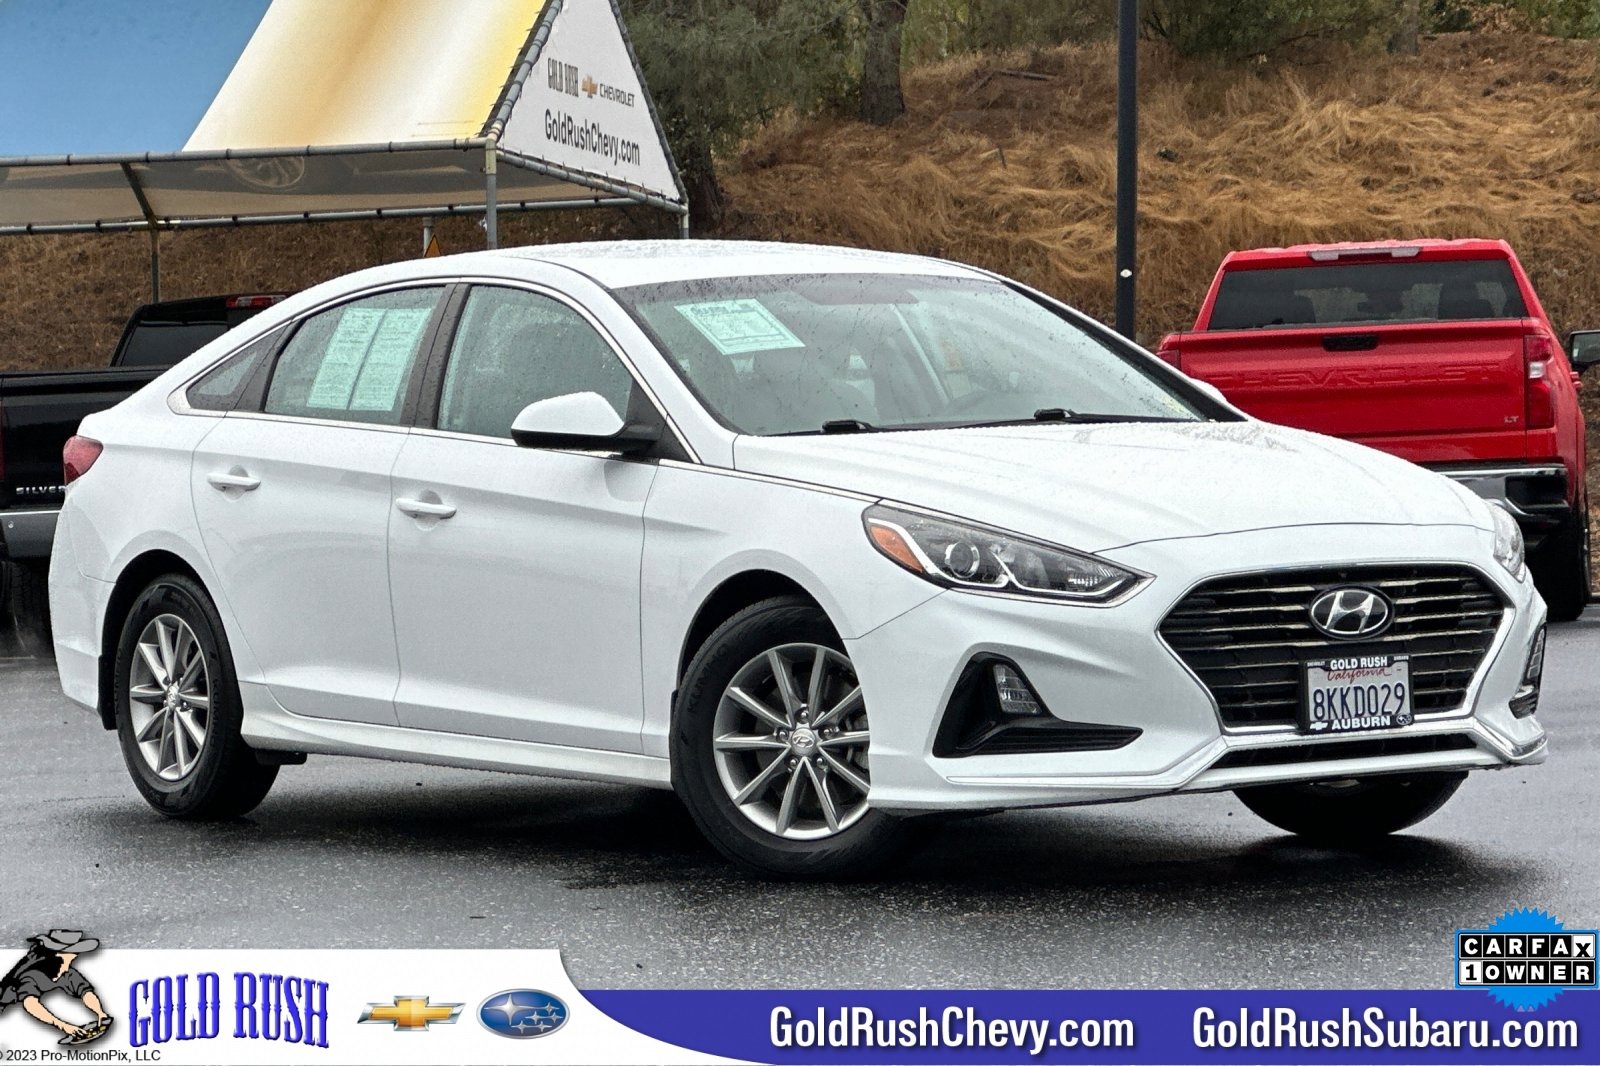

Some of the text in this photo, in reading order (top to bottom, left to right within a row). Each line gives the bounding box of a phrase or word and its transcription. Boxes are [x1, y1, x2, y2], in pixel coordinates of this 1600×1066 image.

[547, 57, 635, 107] GOLD RUSH CHEVROLET
[544, 108, 640, 166] GoldRushChevy.com
[1204, 362, 1500, 391] CHEVROLET
[1327, 667, 1393, 684] California
[1330, 659, 1358, 671] GOLD
[1360, 656, 1388, 668] RUSH
[1313, 682, 1406, 720] 8KKD029
[1331, 715, 1391, 731] AUBURN
